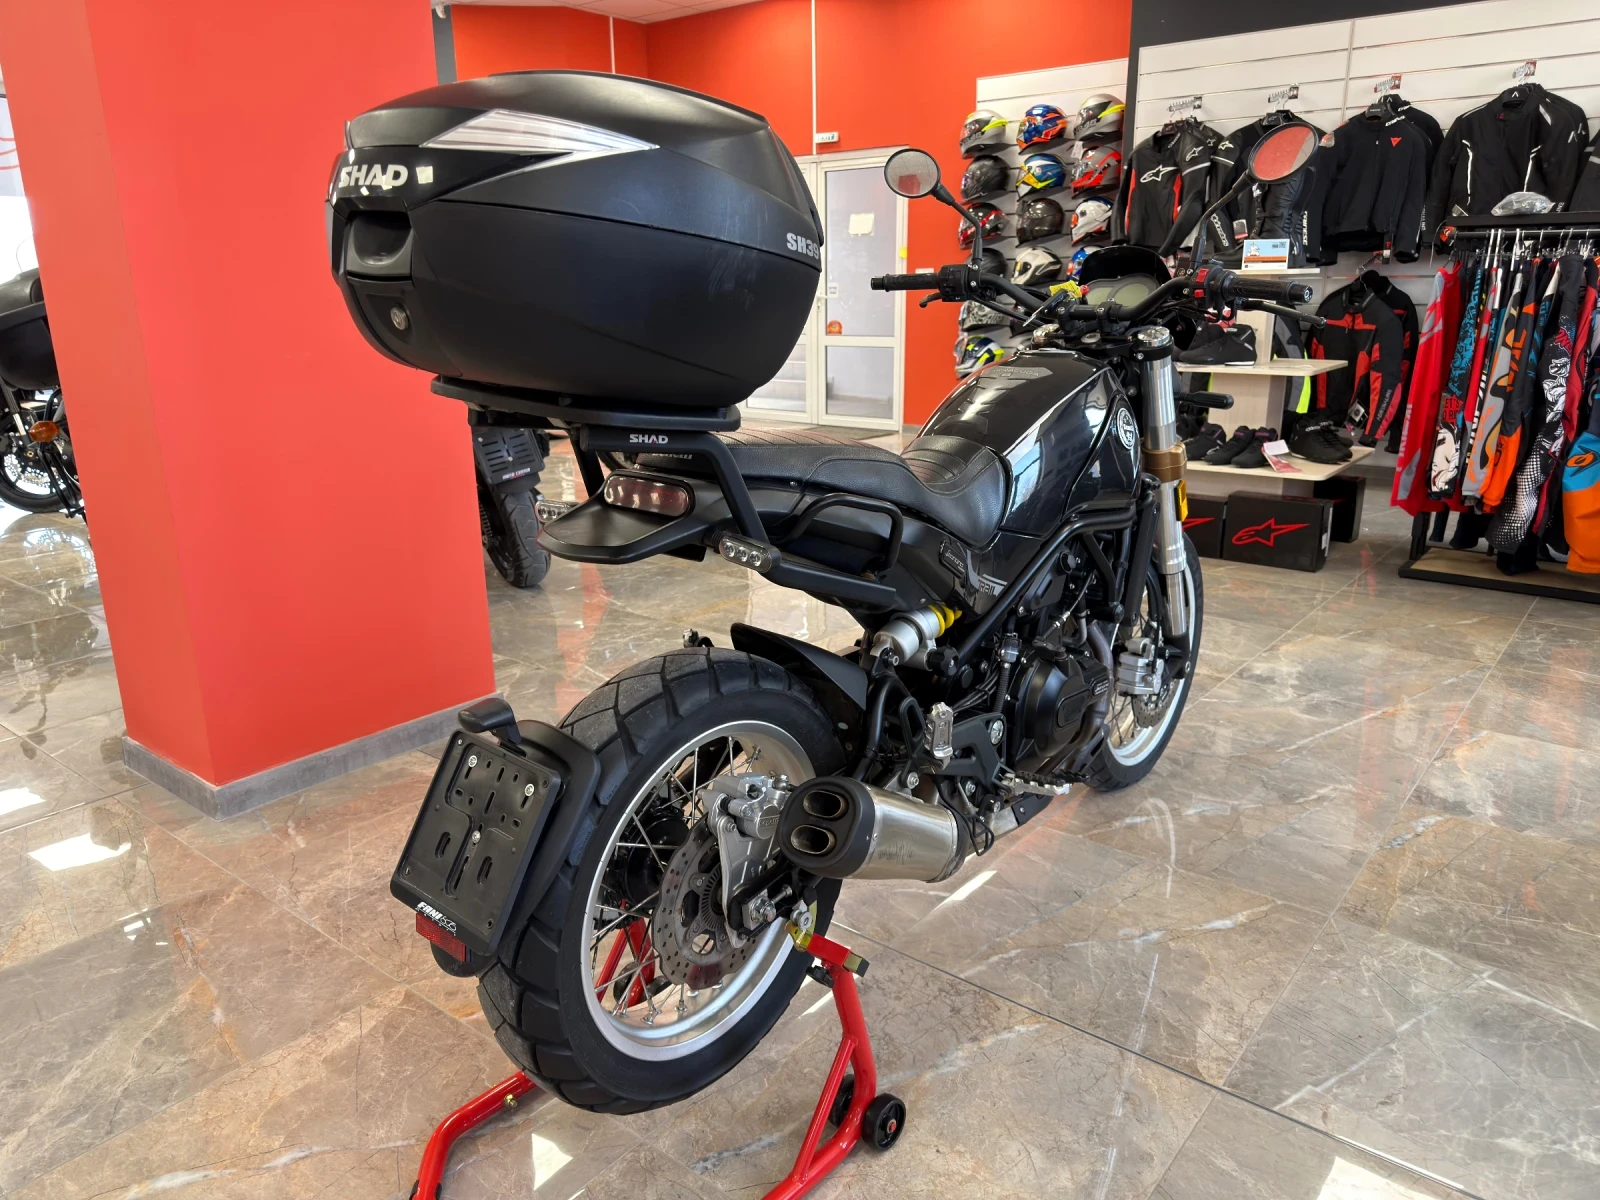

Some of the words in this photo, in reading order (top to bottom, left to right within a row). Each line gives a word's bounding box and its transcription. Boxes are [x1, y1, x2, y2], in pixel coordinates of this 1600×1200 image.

[338, 164, 409, 189] SHAD
[786, 232, 820, 260] SH39
[629, 433, 669, 445] SHAD
[416, 901, 443, 920] FANI
